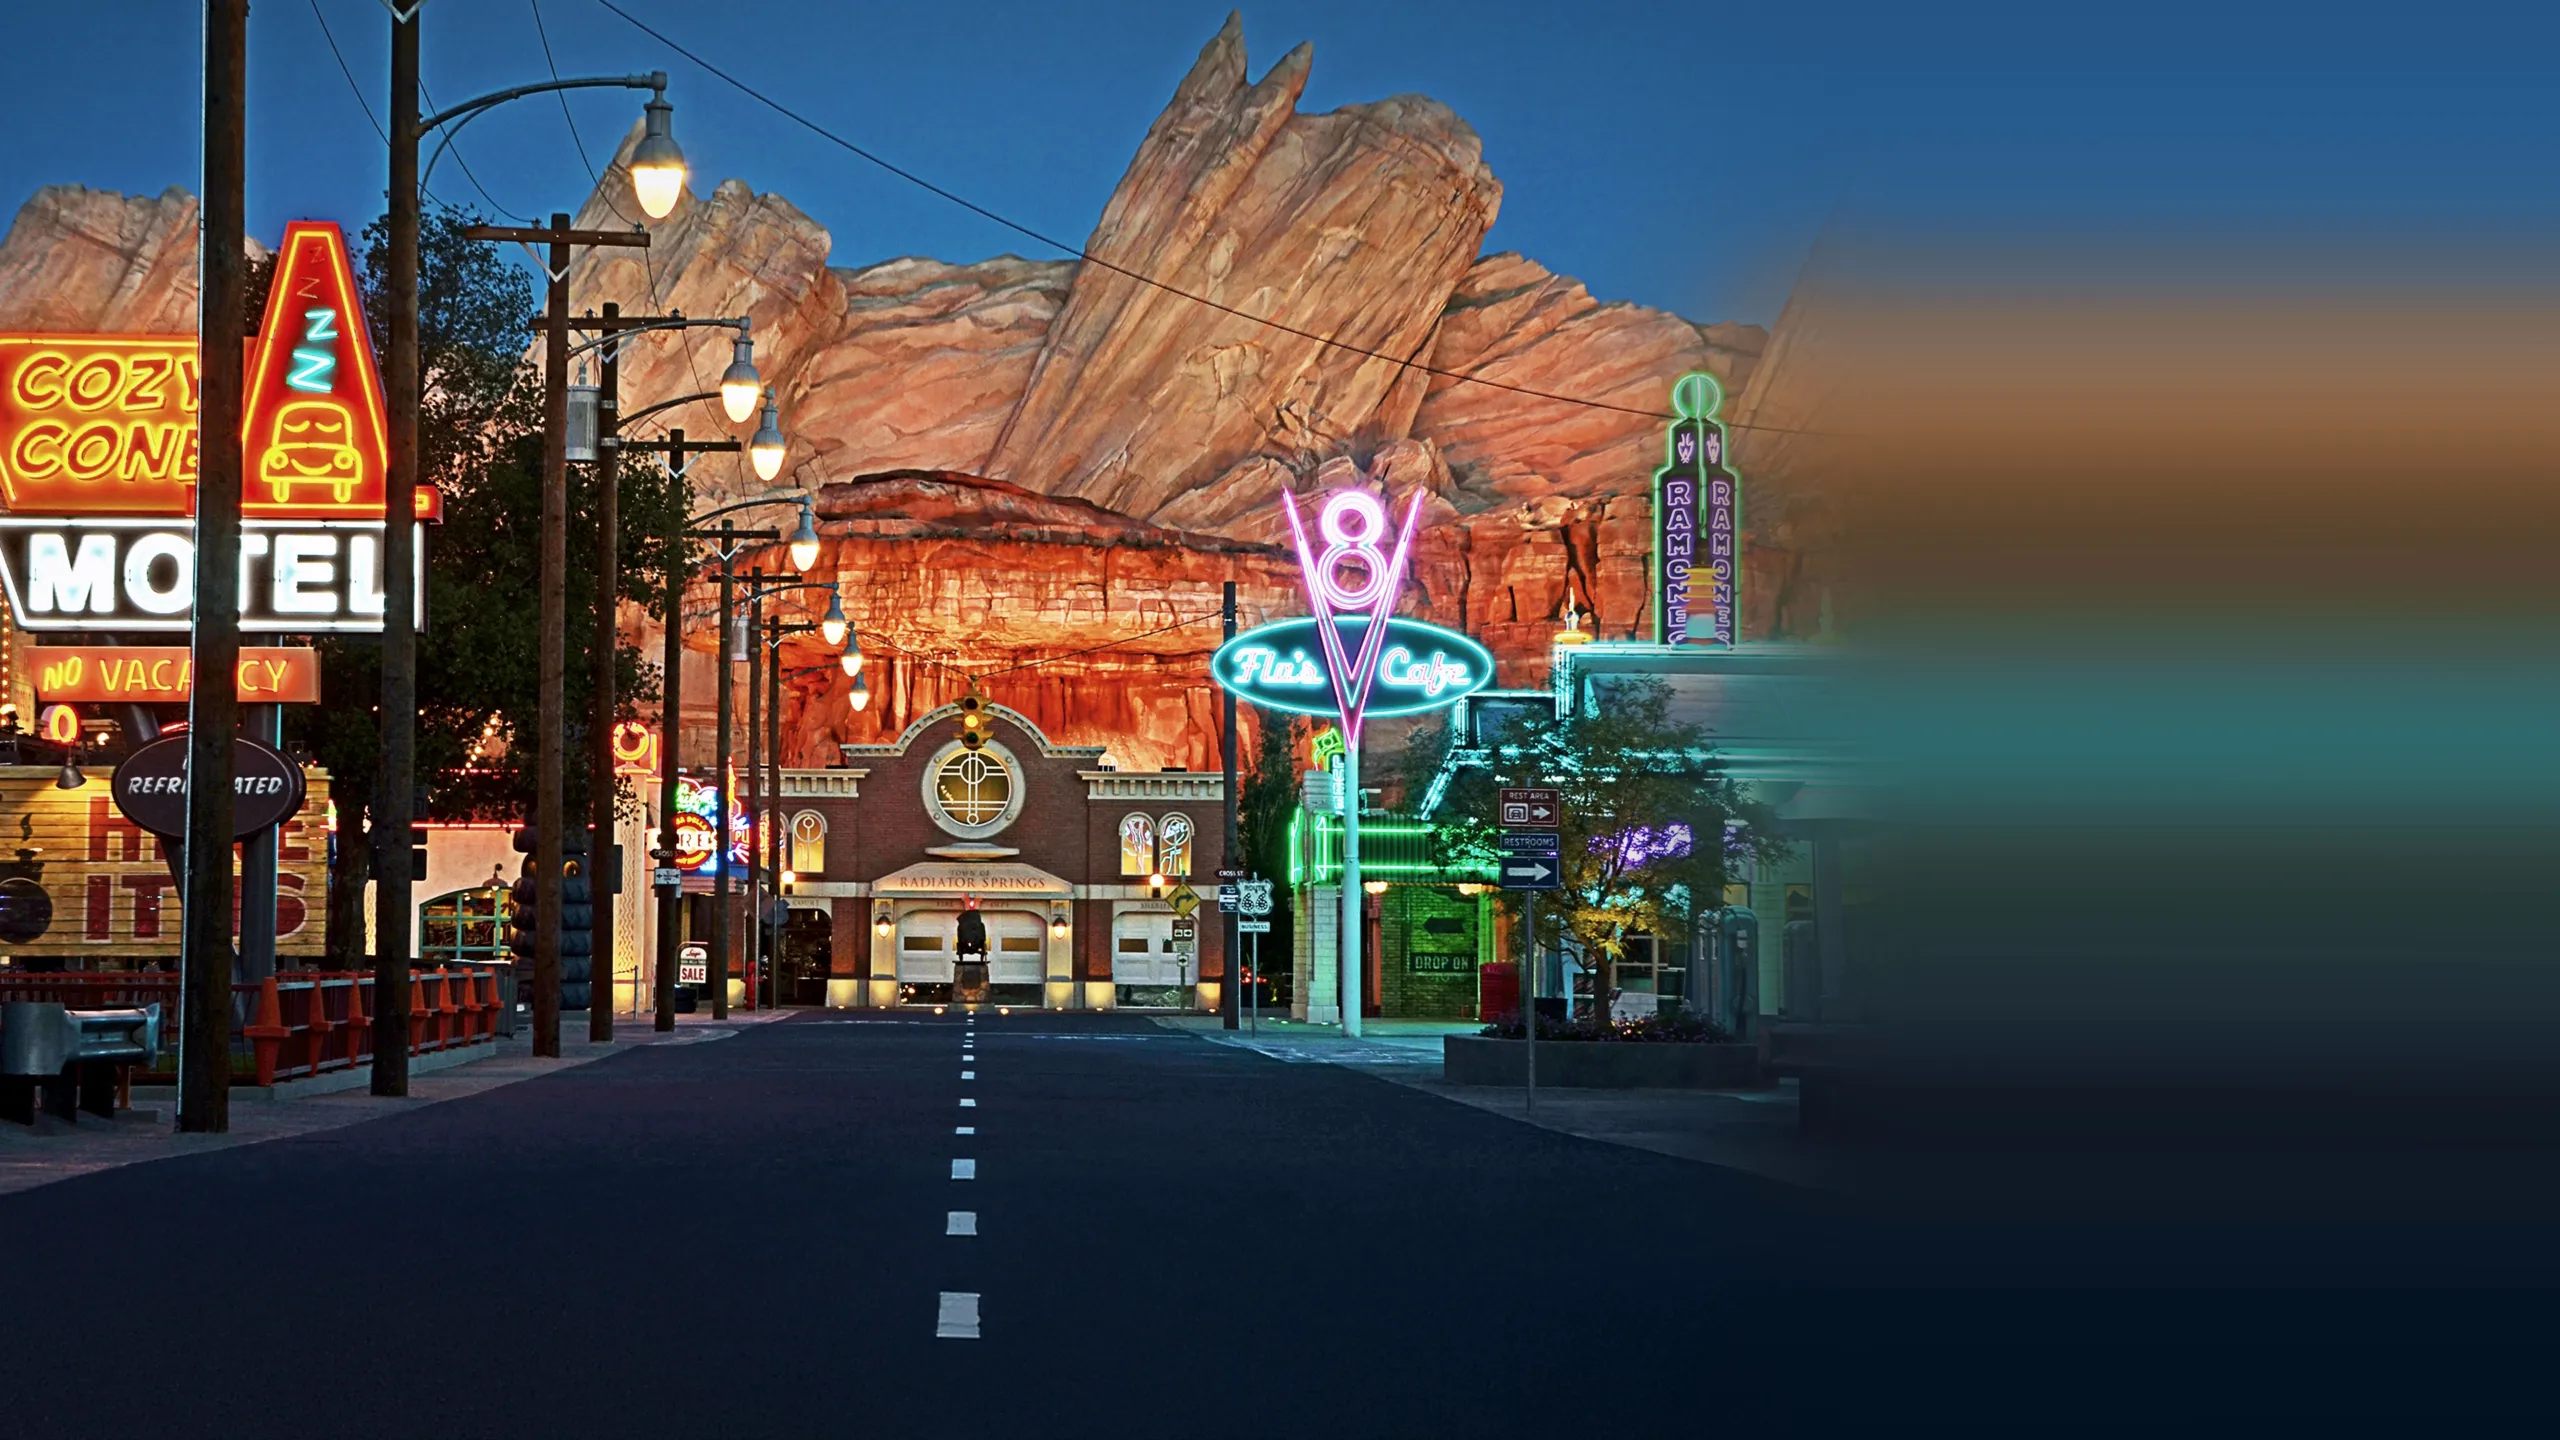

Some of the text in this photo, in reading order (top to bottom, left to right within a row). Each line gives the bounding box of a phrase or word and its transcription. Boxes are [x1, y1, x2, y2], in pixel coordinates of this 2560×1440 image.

[43, 656, 288, 692] NO VACACY
[1234, 646, 1472, 696] Flo's Cafe
[128, 776, 283, 795] REFRIATED
[1529, 792, 1550, 800] AREA
[1504, 838, 1555, 846] RESTROOMS
[900, 877, 1046, 888] RADIATOR SPRINGS
[1241, 892, 1268, 910] 66
[1415, 956, 1448, 970] DROP
[1452, 956, 1468, 970] ON
[681, 967, 704, 980] SALE
